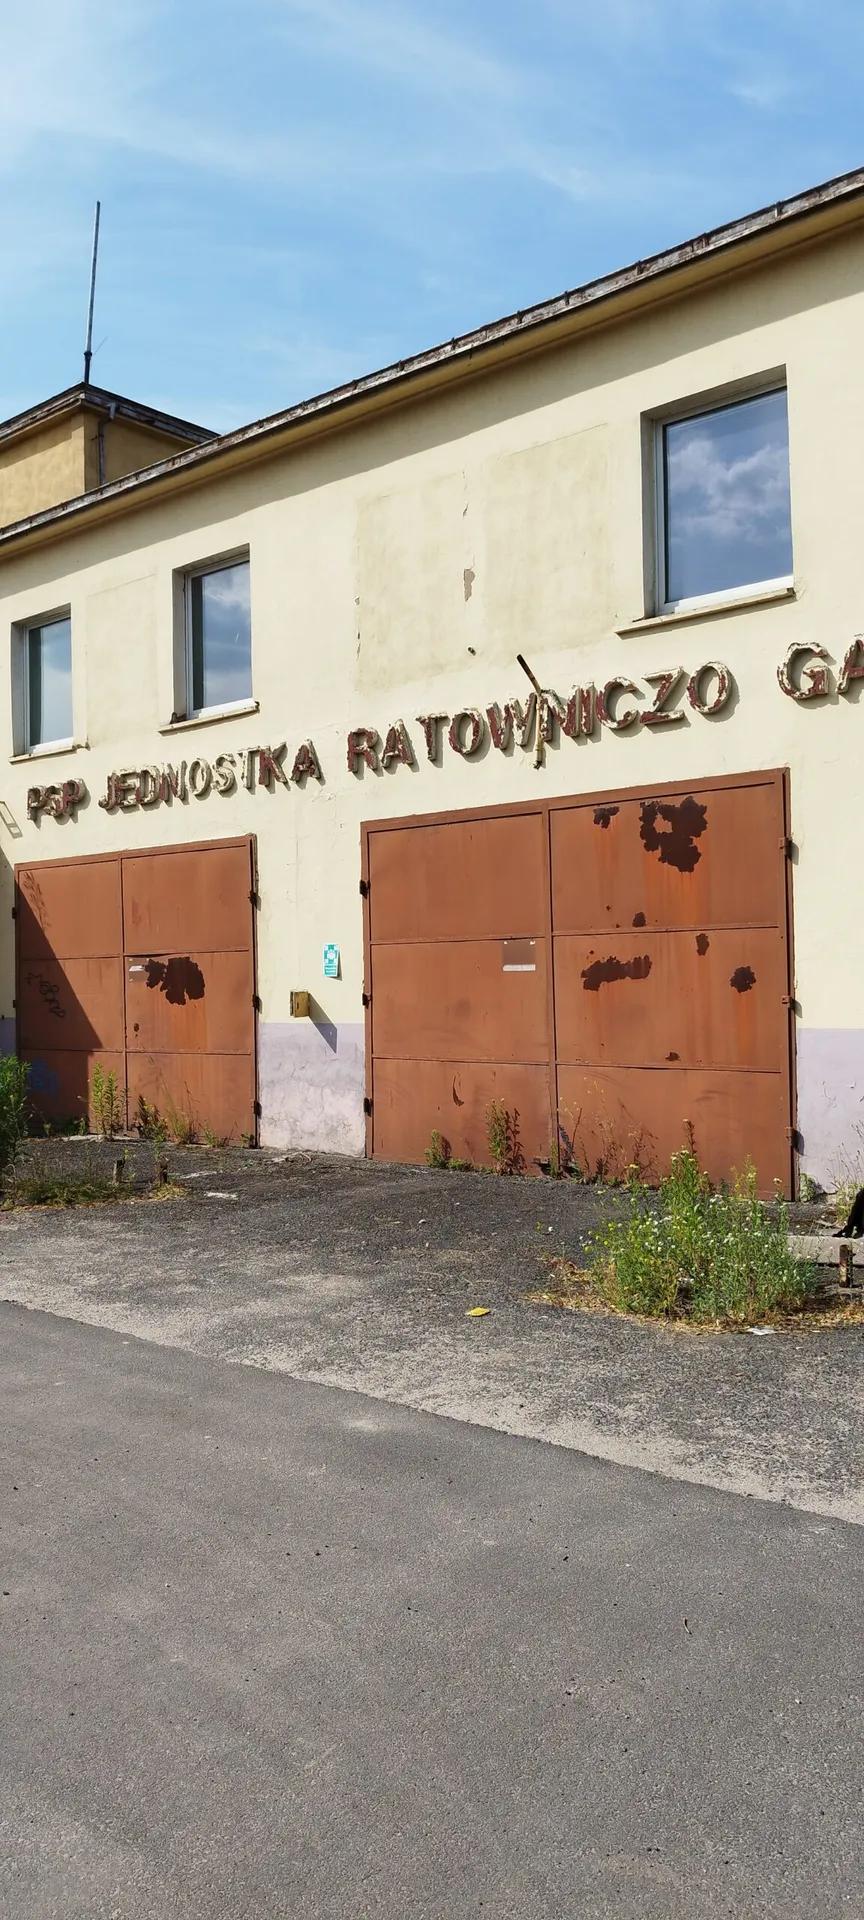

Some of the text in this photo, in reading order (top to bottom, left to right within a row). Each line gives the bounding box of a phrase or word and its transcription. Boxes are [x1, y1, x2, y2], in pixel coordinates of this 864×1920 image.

[27, 779, 87, 821] PSP
[98, 739, 323, 811] JEDNOSTKA
[348, 661, 732, 774] RATOWNICZO
